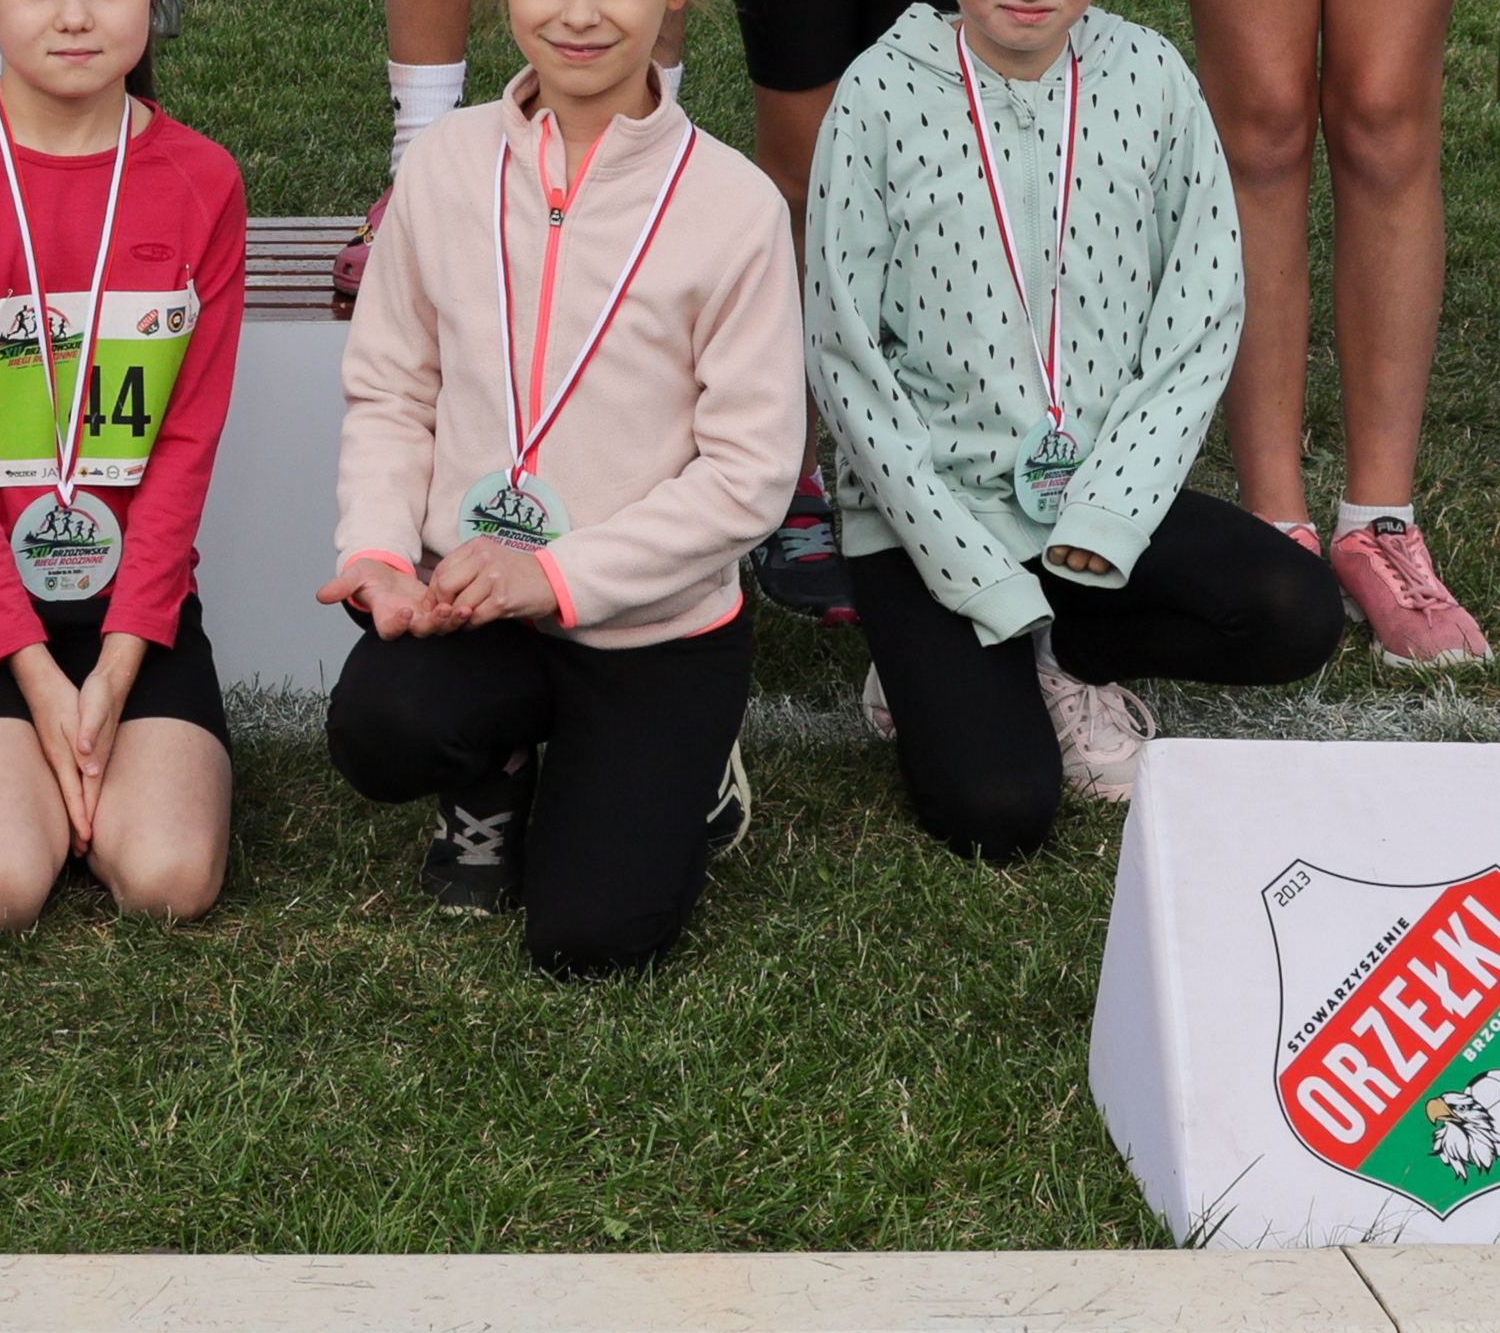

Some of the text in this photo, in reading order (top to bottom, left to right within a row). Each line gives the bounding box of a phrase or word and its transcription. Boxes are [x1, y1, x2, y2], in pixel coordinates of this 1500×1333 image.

[68, 365, 152, 438] 44
[1376, 522, 1404, 533] FILA
[51, 545, 110, 558] BRZOZOWSKIE
[58, 555, 105, 566] RODZINNE
[1273, 871, 1311, 908] 2013
[1287, 916, 1410, 1054] STOWARZYSZENIE
